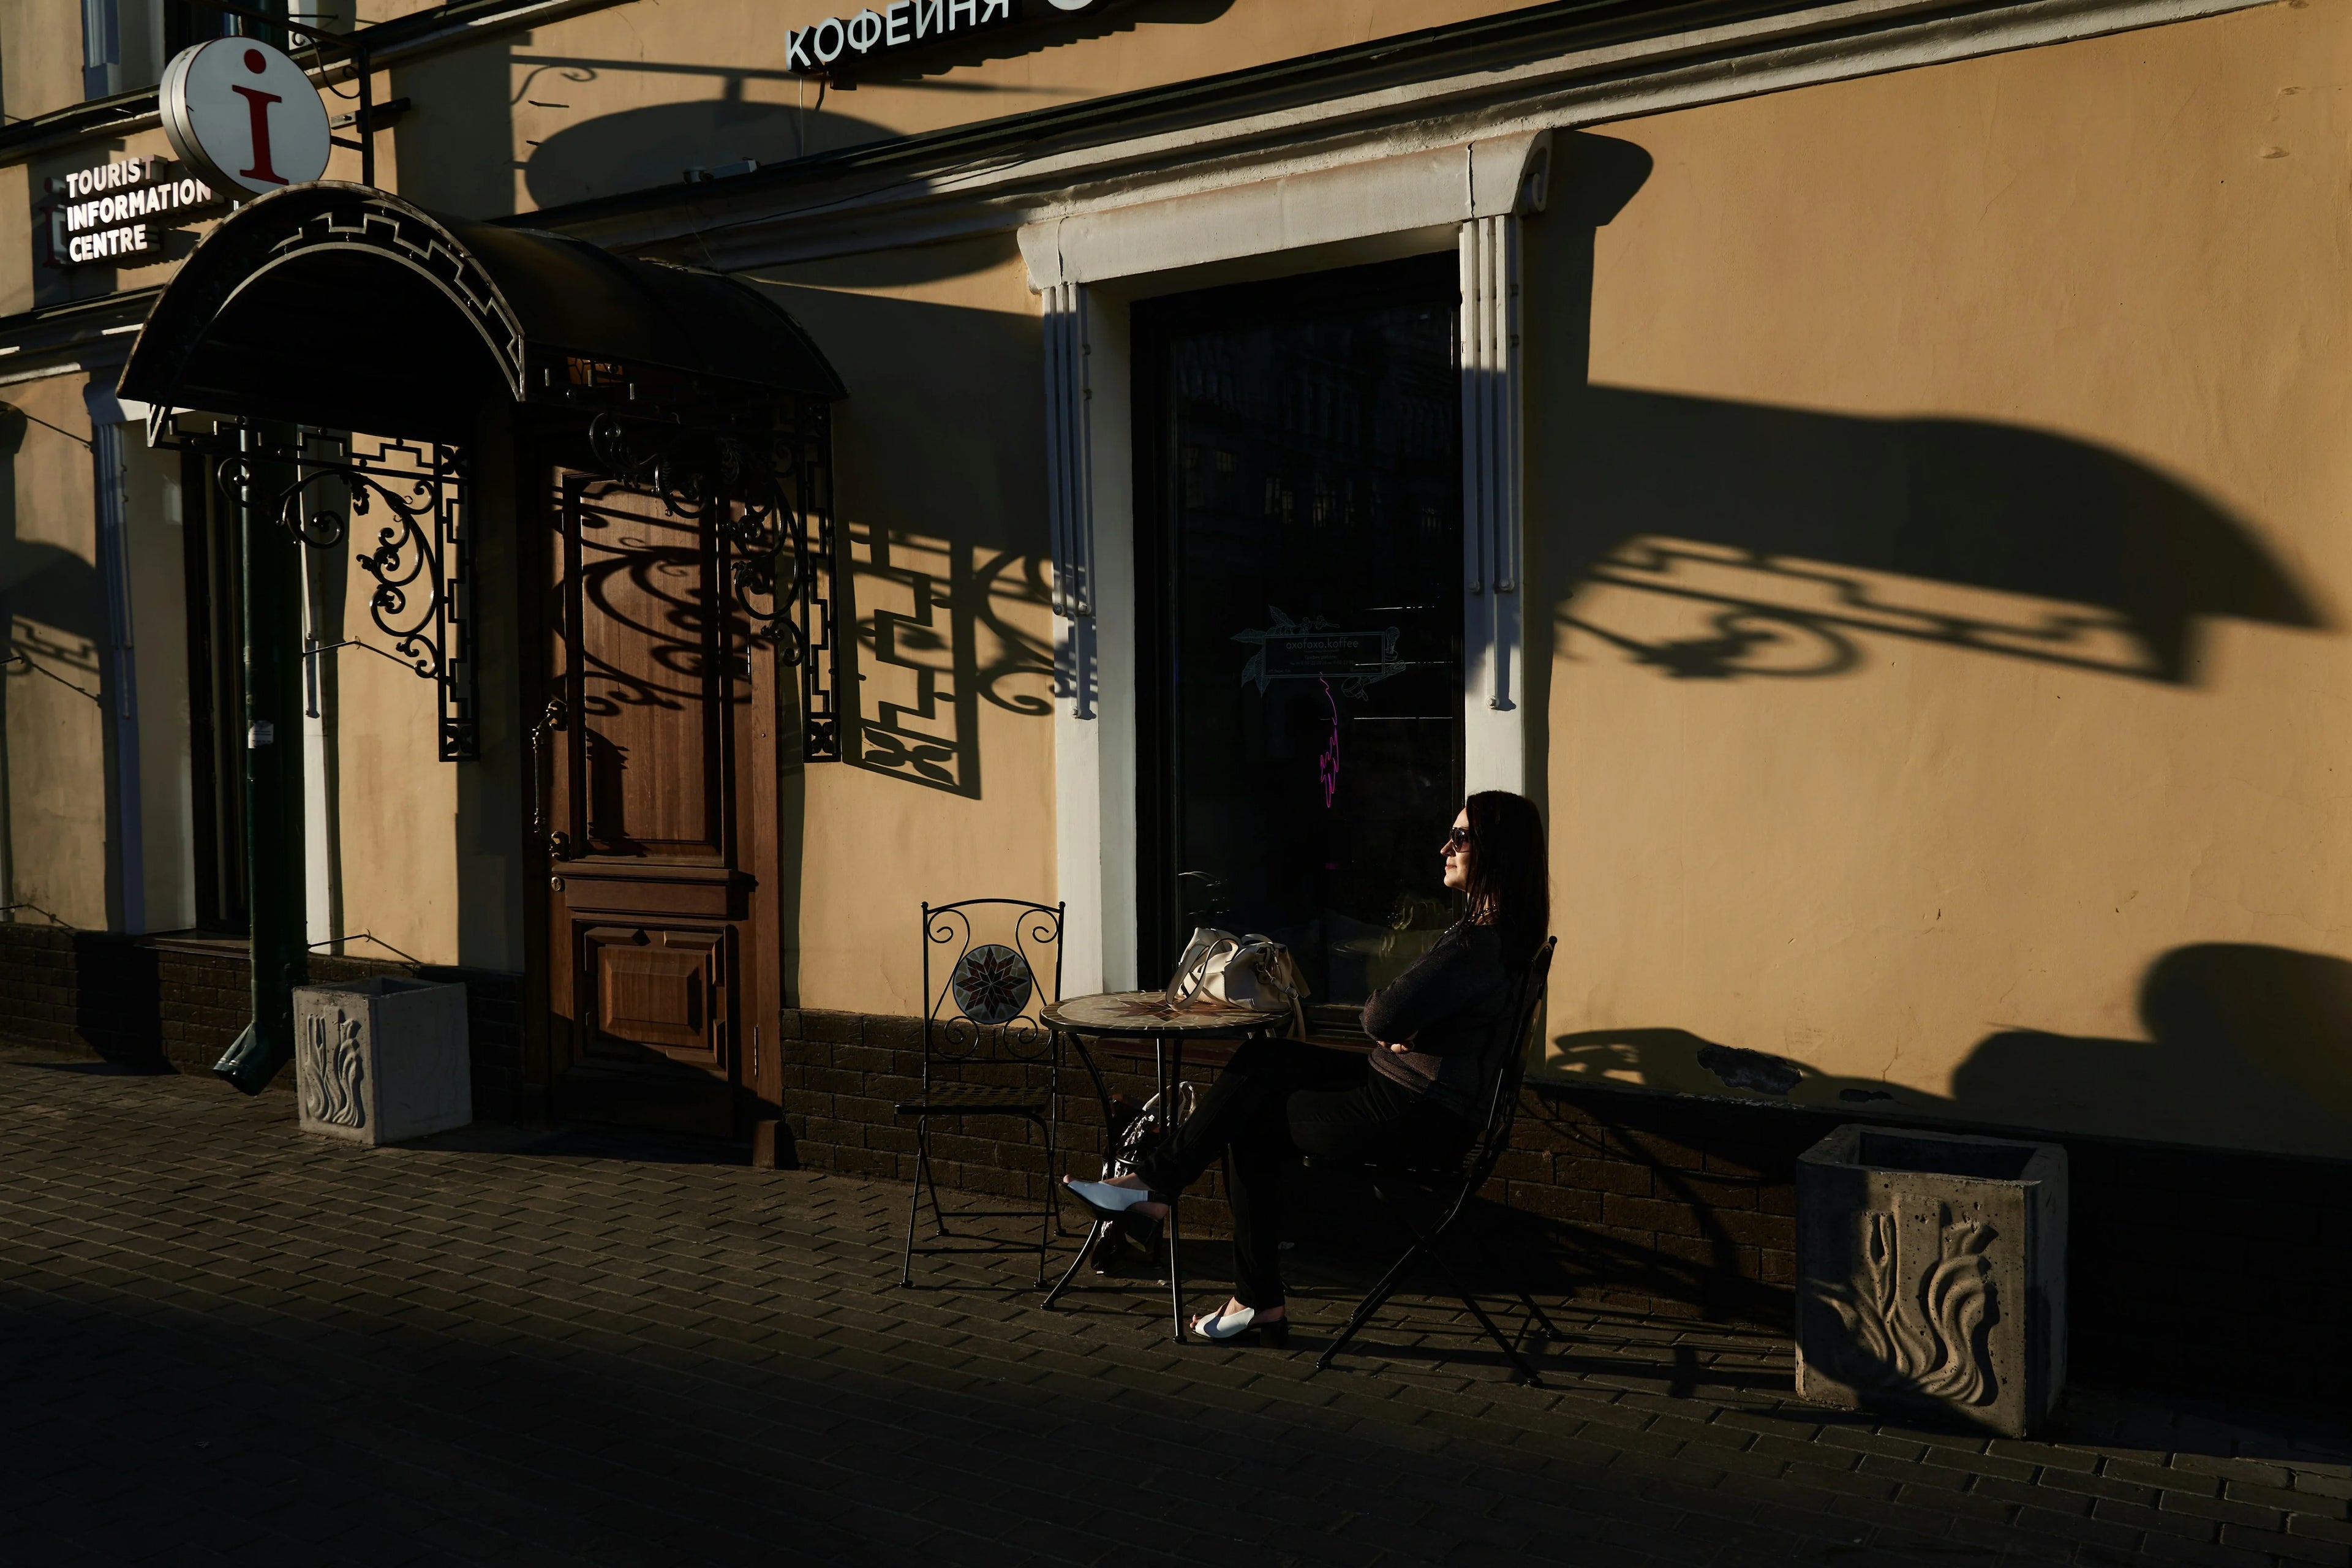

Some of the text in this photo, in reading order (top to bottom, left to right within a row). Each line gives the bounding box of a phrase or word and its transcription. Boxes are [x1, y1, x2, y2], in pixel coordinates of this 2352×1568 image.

[66, 155, 154, 198] TOURIST
[67, 178, 211, 232] INFORMATION
[69, 224, 148, 262] CENTRE
[1286, 636, 1359, 649] oxofoxo.koffee
